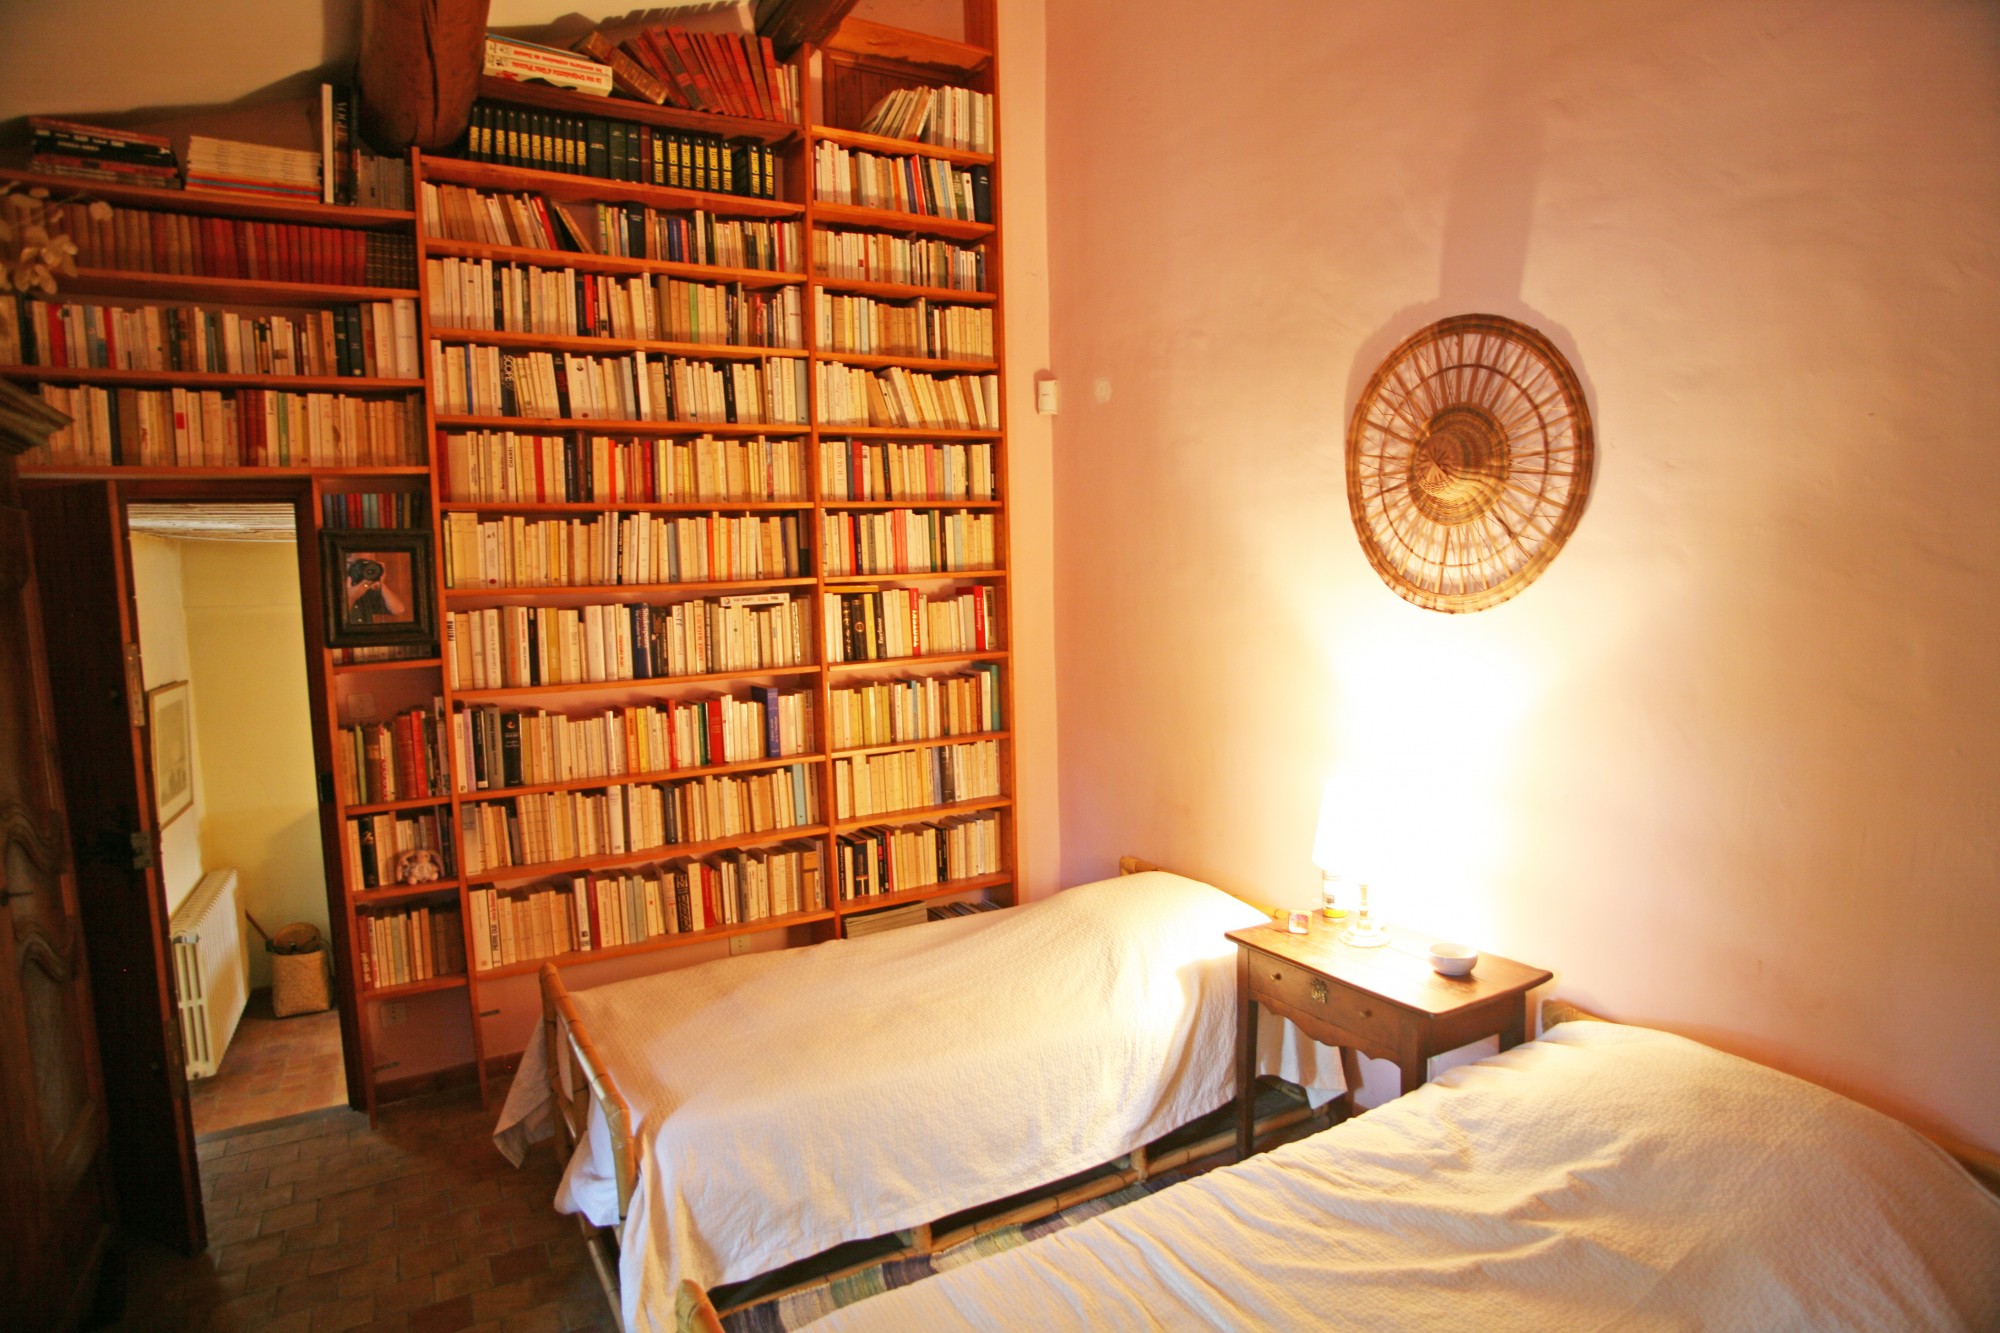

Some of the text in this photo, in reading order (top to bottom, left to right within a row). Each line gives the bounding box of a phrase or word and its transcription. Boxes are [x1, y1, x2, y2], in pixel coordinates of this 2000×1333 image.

[653, 139, 664, 183] AGATHA CHRISTIE
[668, 142, 678, 185] AGATHA CHRISTIE
[681, 144, 691, 187] AGATHA CHRISTIE
[695, 146, 704, 188] AGATHA CHRISTIE
[709, 147, 719, 189] AGATHA CHRISTIE
[722, 148, 732, 190] AGATHA CHRISTIE
[751, 152, 760, 194] AGATHA CHRISTIE
[765, 154, 773, 195] AGATHA CHRISTIE
